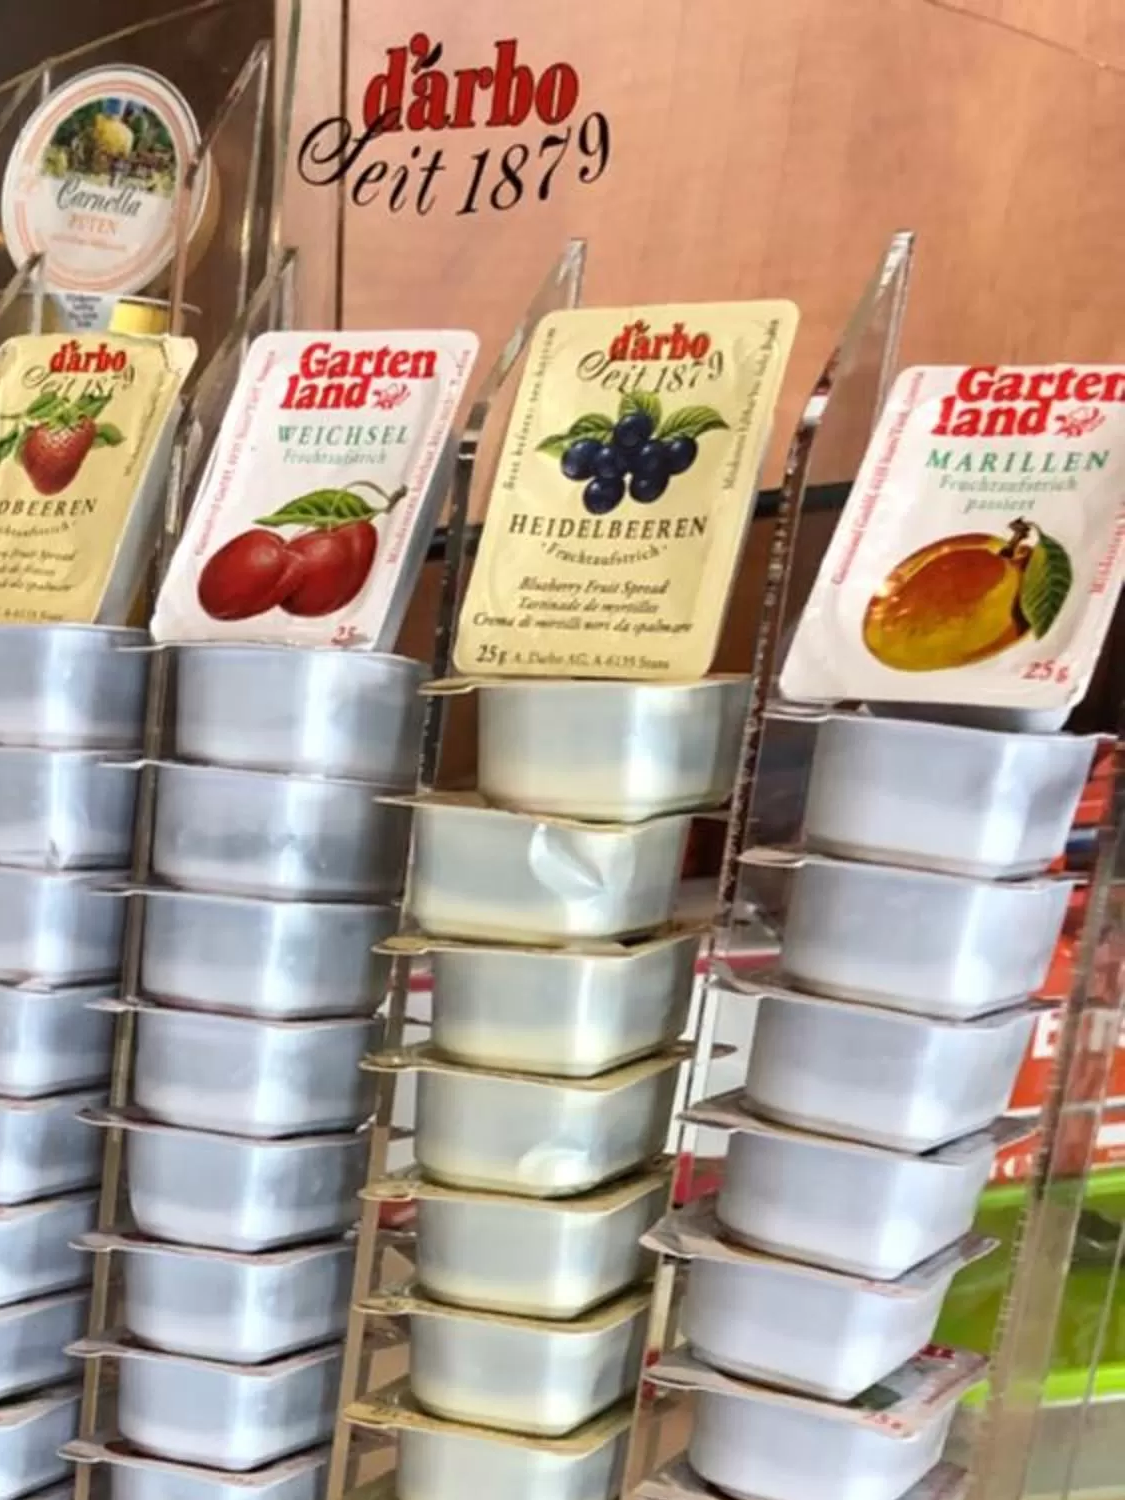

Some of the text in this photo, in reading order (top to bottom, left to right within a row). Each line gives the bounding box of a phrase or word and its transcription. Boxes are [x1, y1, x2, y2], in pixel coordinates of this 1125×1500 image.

[297, 111, 610, 216] Seit 1879
[55, 175, 143, 217] Carnella
[298, 342, 438, 380] Garten
[575, 348, 725, 395] Seit 1879
[279, 375, 371, 411] land
[956, 364, 1125, 403] Garten
[277, 424, 411, 446] WEICHSEL
[930, 395, 1049, 438] land
[925, 448, 1111, 473] MARILLEN
[508, 513, 709, 540] HEIDELBEEREN
